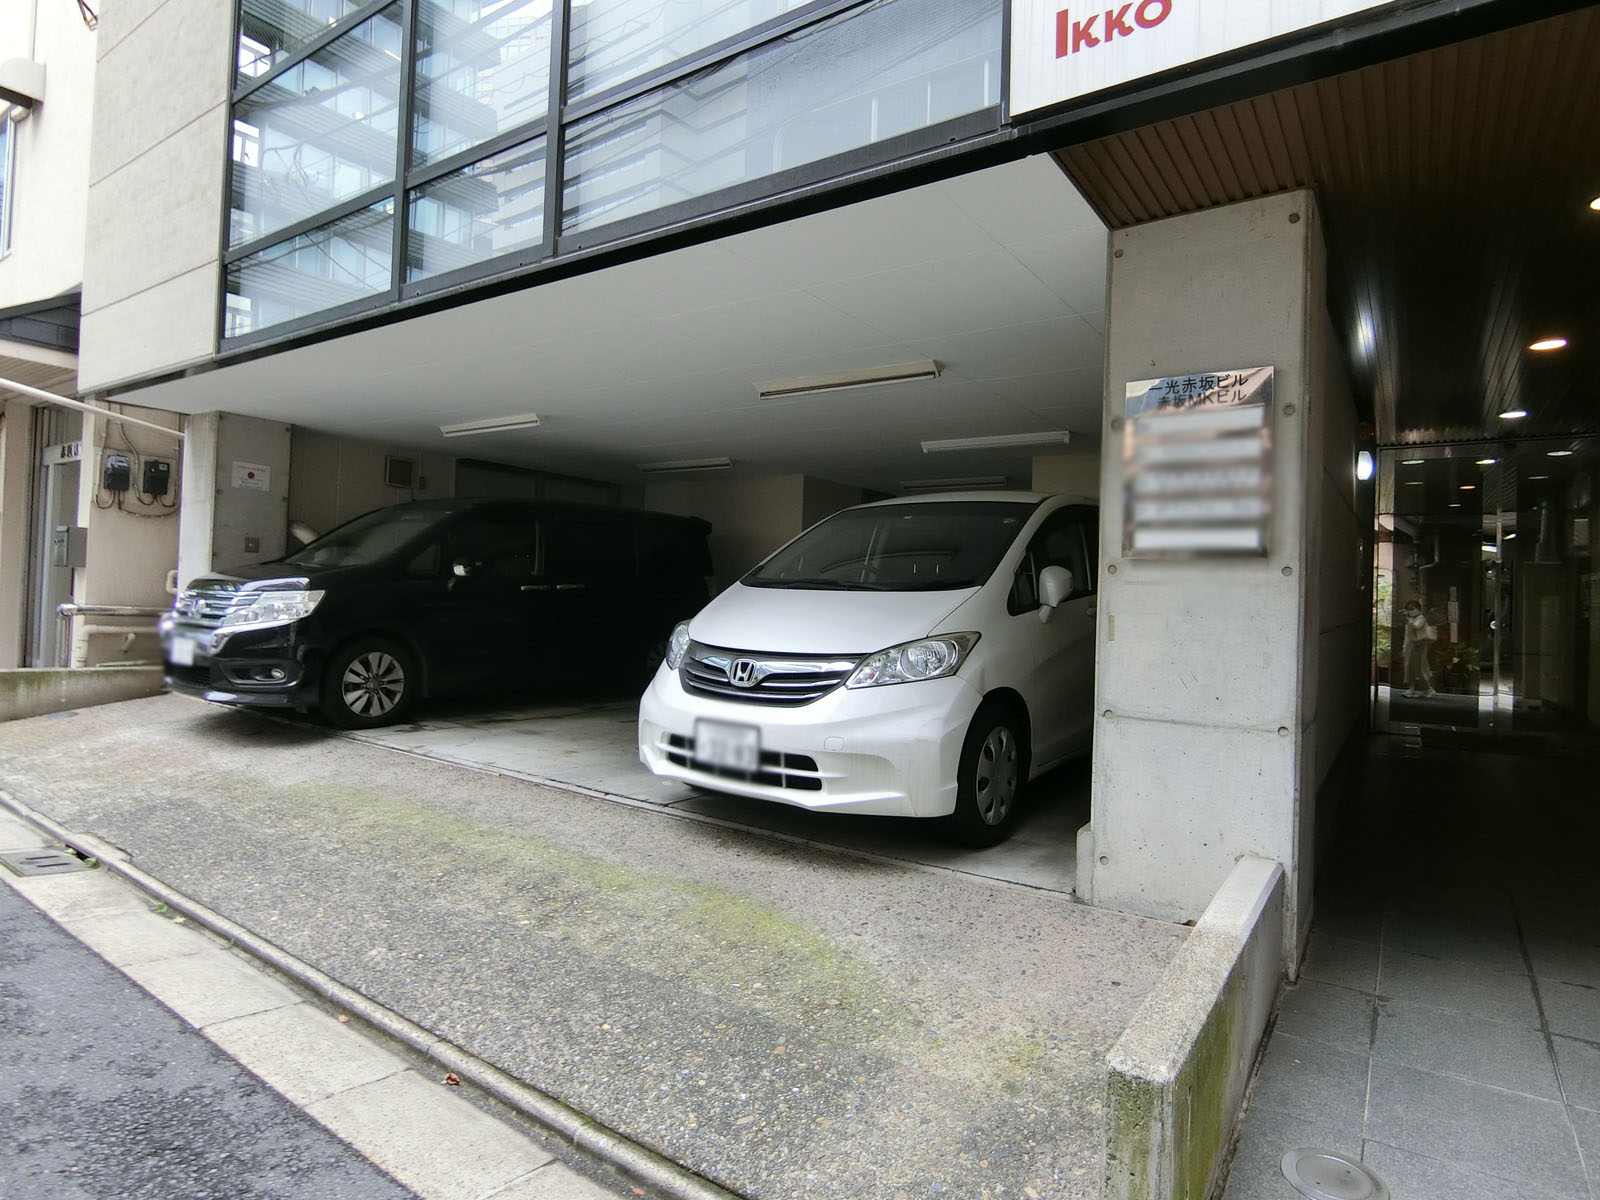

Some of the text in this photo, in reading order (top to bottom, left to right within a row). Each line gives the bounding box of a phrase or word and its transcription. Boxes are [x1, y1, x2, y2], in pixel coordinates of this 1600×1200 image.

[1149, 374, 1249, 395] 一光赤坂ビル
